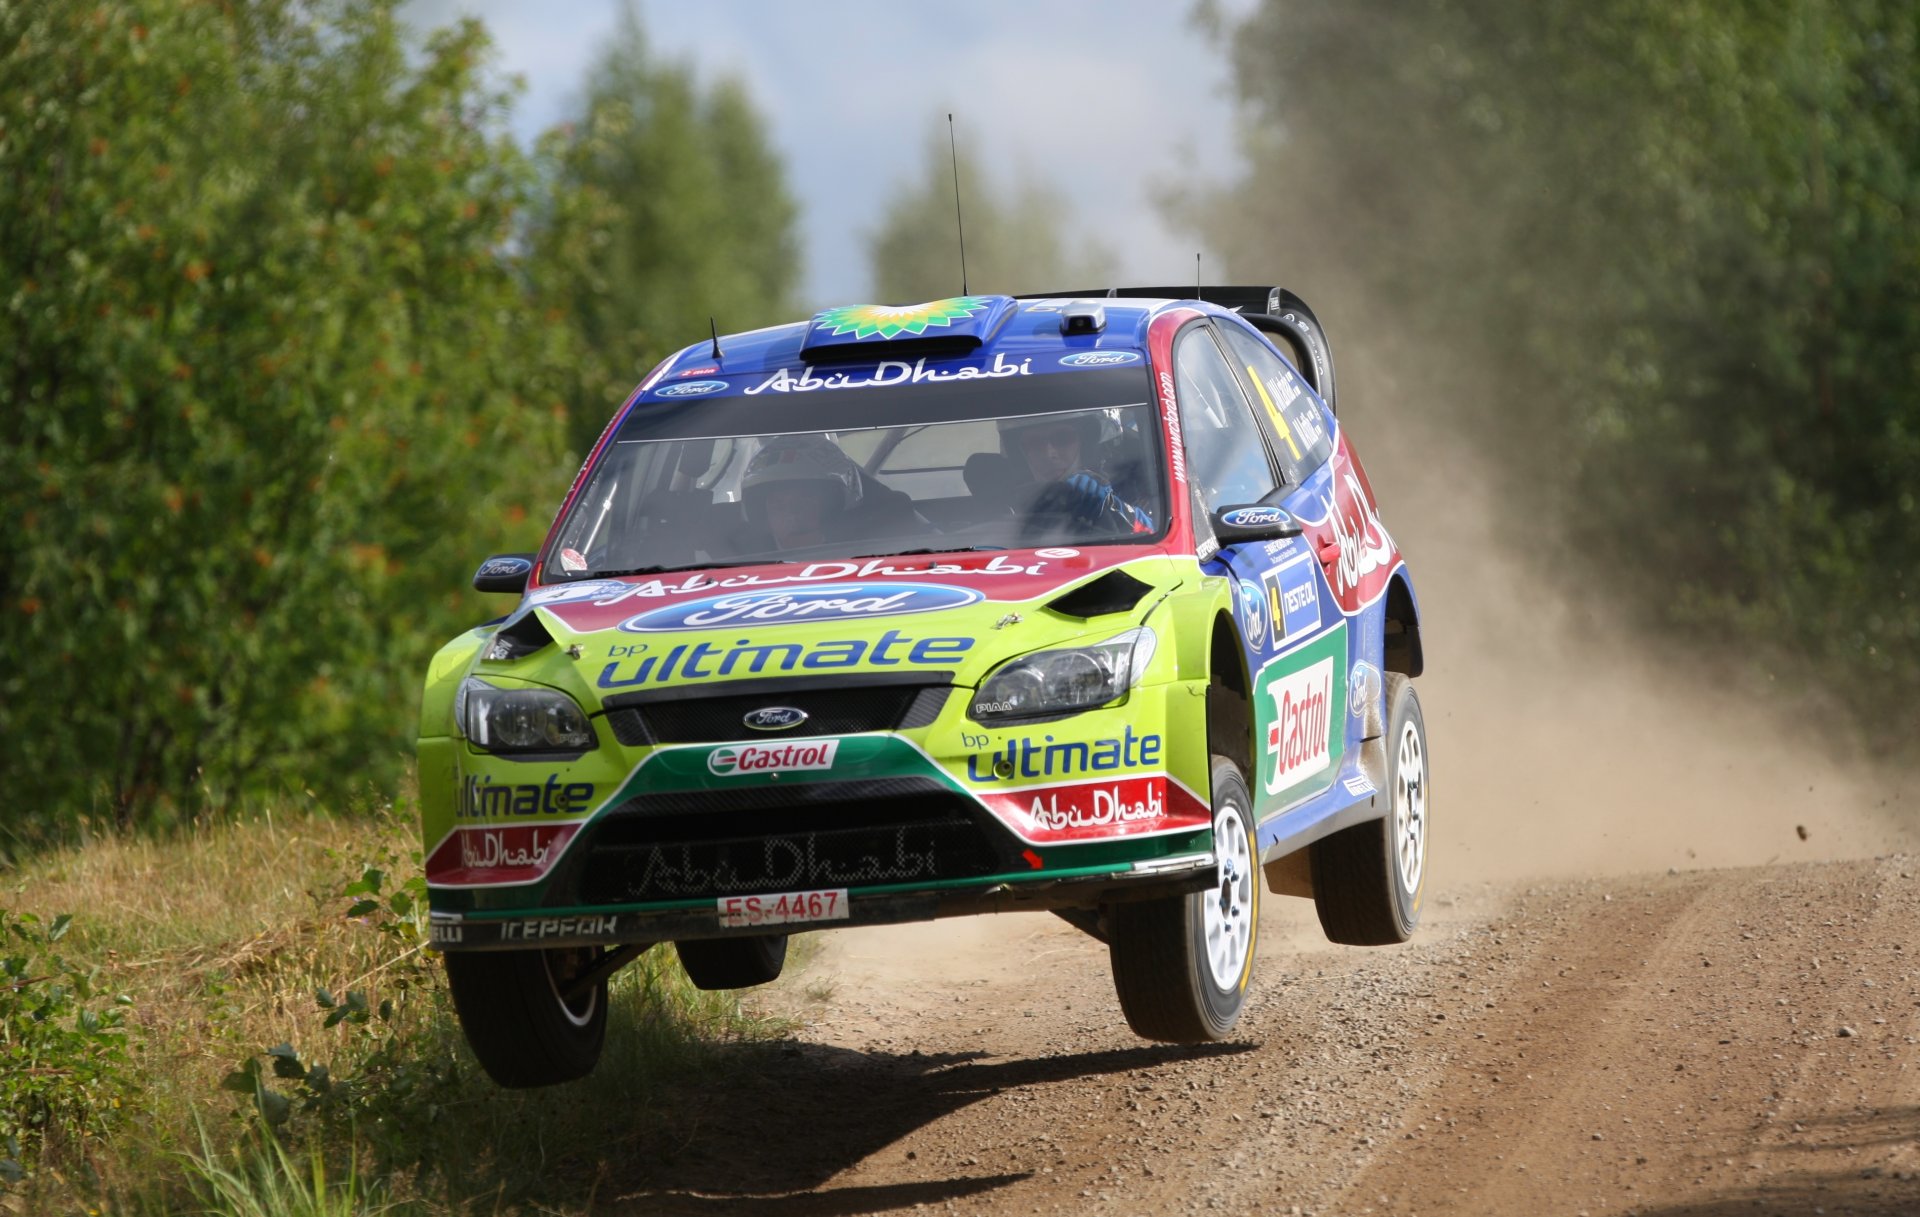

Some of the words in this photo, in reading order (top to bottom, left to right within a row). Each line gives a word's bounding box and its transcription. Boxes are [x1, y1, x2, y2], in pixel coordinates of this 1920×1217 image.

[743, 366, 862, 395] Abu
[866, 353, 1033, 386] Dhabi
[1073, 352, 1126, 365] Ford
[666, 382, 717, 395] Ford
[1246, 365, 1302, 461] 4
[1235, 510, 1281, 524] Ford
[480, 559, 522, 576] Ford
[594, 575, 775, 606] Abu
[786, 556, 1048, 582] Dhabi
[684, 586, 911, 627] Ford
[1271, 586, 1281, 631] 4
[597, 629, 976, 689] ultimate
[608, 642, 649, 659] bp
[756, 709, 791, 725] Ford
[974, 701, 1013, 714] PIAA
[1278, 672, 1329, 776] Castrol
[738, 743, 829, 771] Castrol
[961, 732, 990, 751] bp
[967, 724, 1162, 783] ultimate
[1024, 793, 1089, 831] Abu
[1087, 781, 1166, 827] Dhabi
[484, 829, 551, 868] Dhabi
[627, 846, 746, 897] Abu
[748, 825, 939, 888] Dhabi
[724, 891, 840, 926] ES-4467
